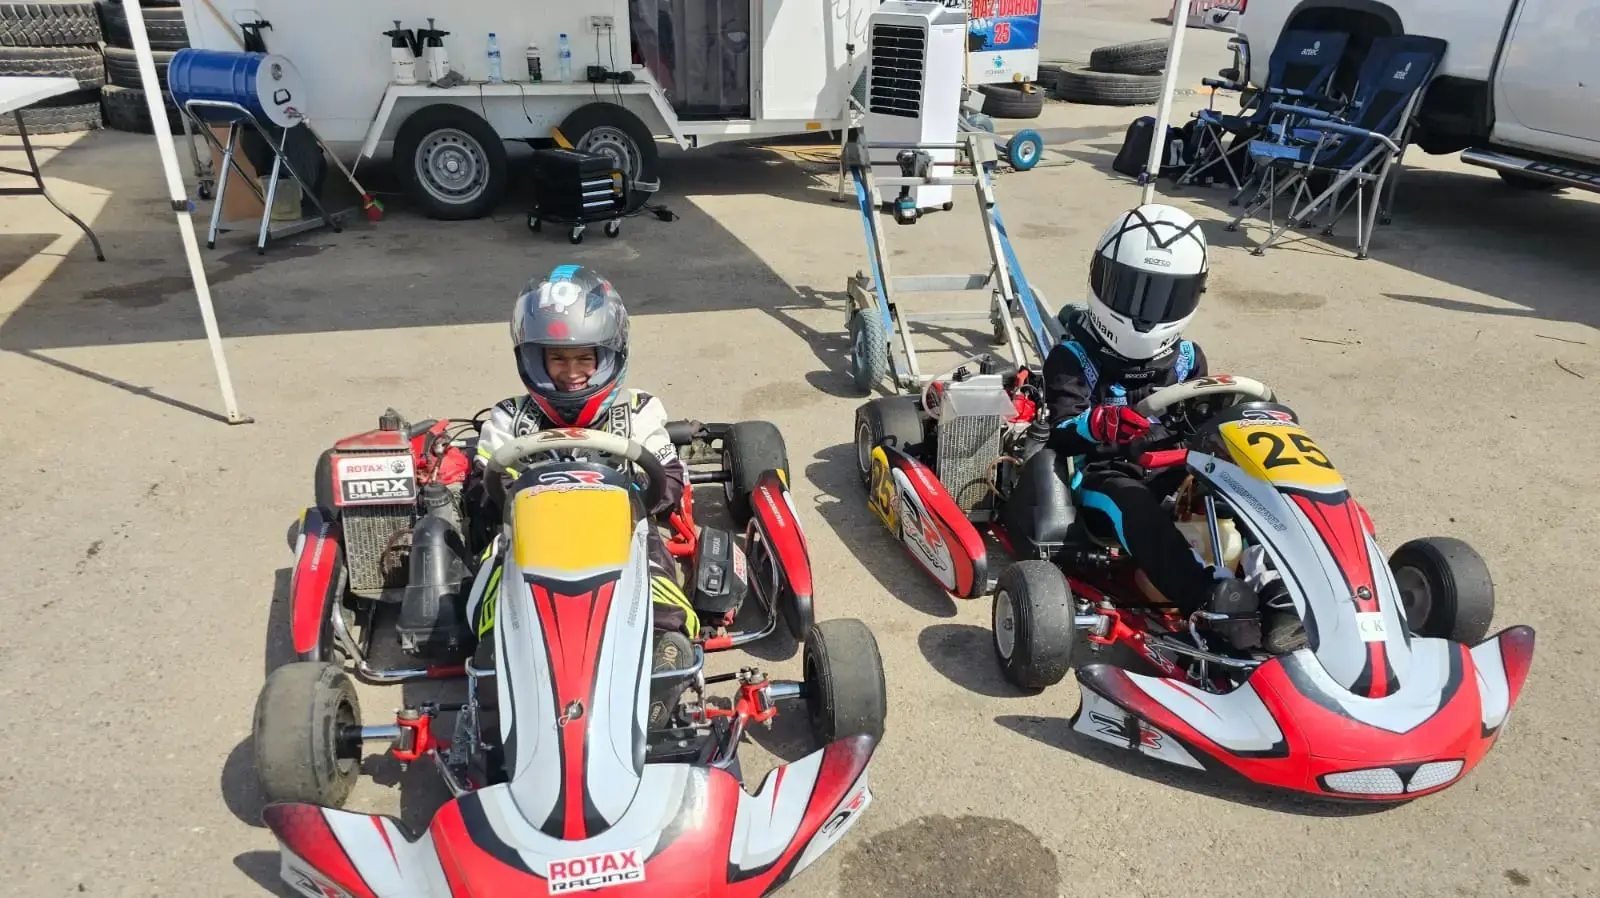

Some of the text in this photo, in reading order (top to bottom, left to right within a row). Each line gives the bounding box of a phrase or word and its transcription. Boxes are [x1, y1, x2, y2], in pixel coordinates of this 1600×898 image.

[972, 0, 994, 18] RAZ
[994, 23, 1010, 44] 25
[1088, 308, 1115, 342] ahan
[1247, 431, 1335, 470] 25
[346, 464, 384, 474] ROTAX
[549, 850, 637, 880] ROTAX
[552, 870, 640, 891] RACING
